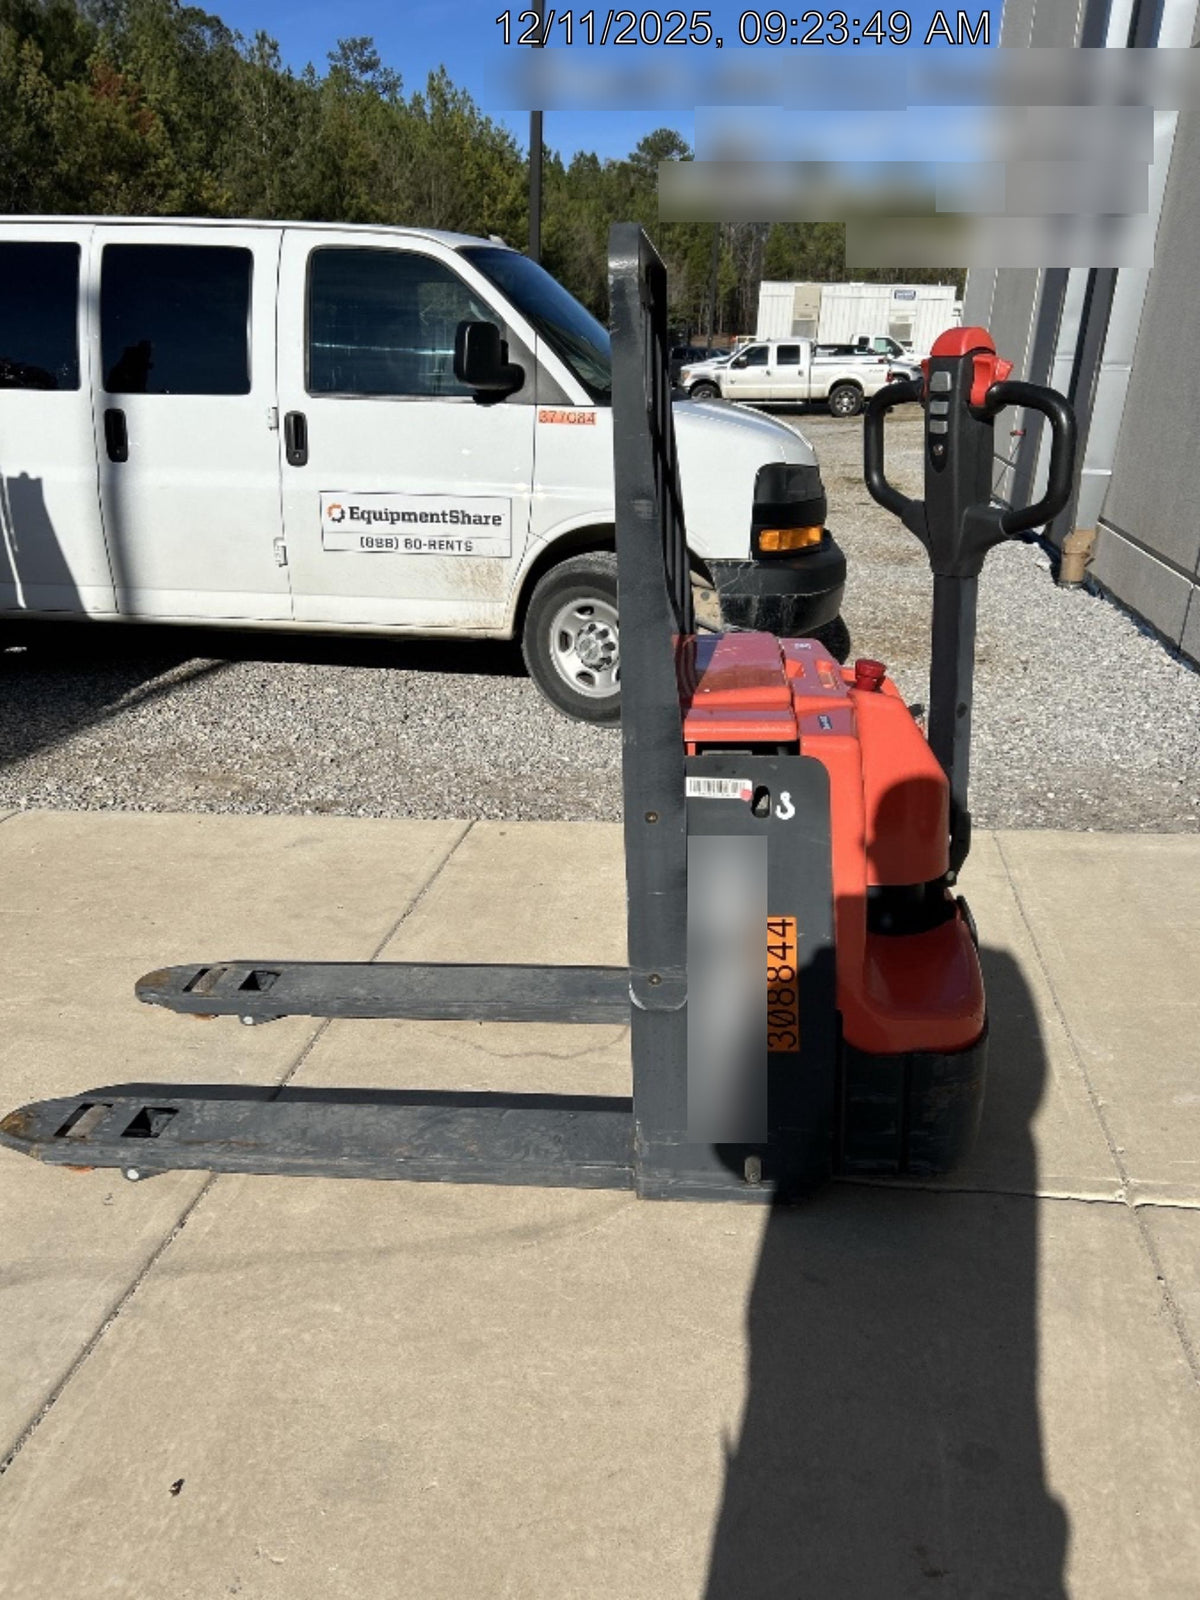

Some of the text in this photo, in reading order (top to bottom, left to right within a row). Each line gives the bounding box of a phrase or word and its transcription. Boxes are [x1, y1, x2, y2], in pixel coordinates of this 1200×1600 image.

[539, 410, 597, 425] 377084
[348, 506, 503, 526] EquipmentShare
[360, 536, 399, 550] (888)
[767, 918, 797, 1049] 308844
